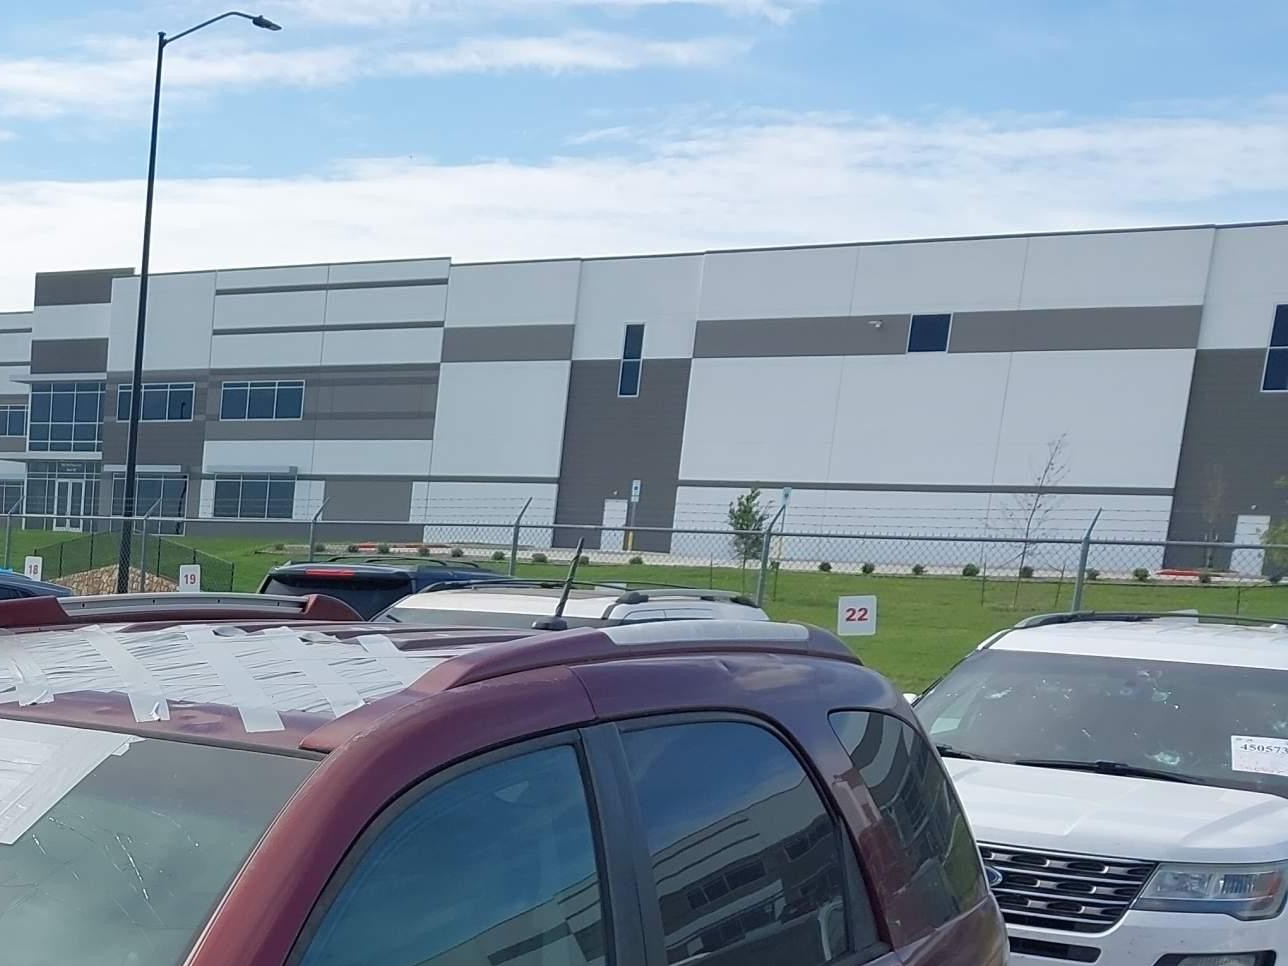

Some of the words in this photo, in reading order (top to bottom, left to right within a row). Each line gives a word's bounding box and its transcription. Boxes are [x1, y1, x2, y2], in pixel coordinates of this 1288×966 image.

[28, 564, 39, 575] 18
[183, 574, 196, 585] 19
[845, 607, 869, 622] 22
